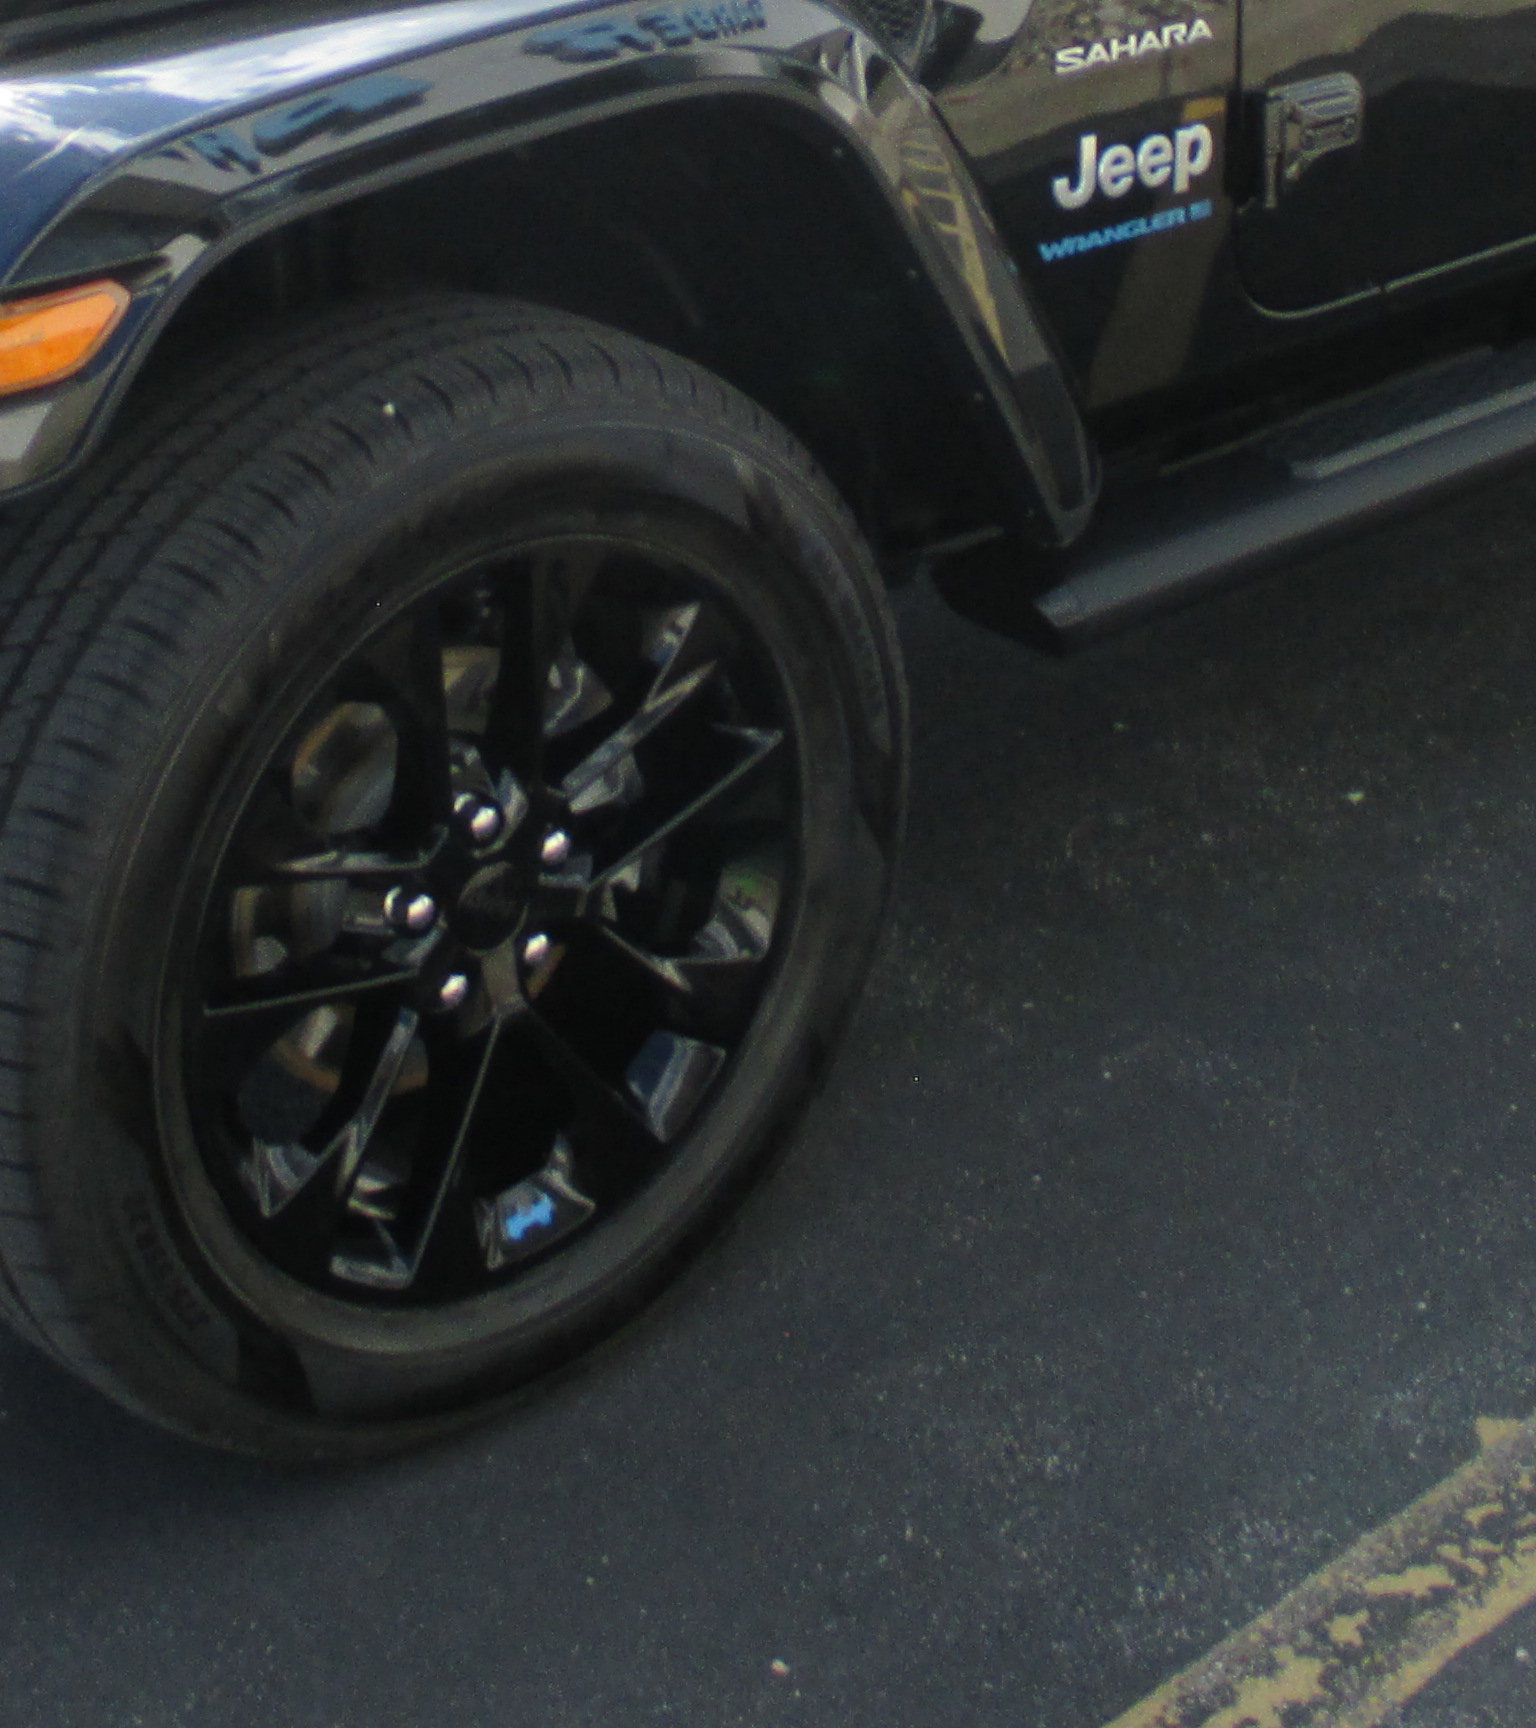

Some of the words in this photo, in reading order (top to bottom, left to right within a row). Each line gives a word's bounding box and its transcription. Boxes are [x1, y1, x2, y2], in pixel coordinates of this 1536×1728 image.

[1055, 18, 1213, 74] SAHARA
[1052, 123, 1213, 210] Jeep
[1038, 206, 1187, 263] WRANGLER
